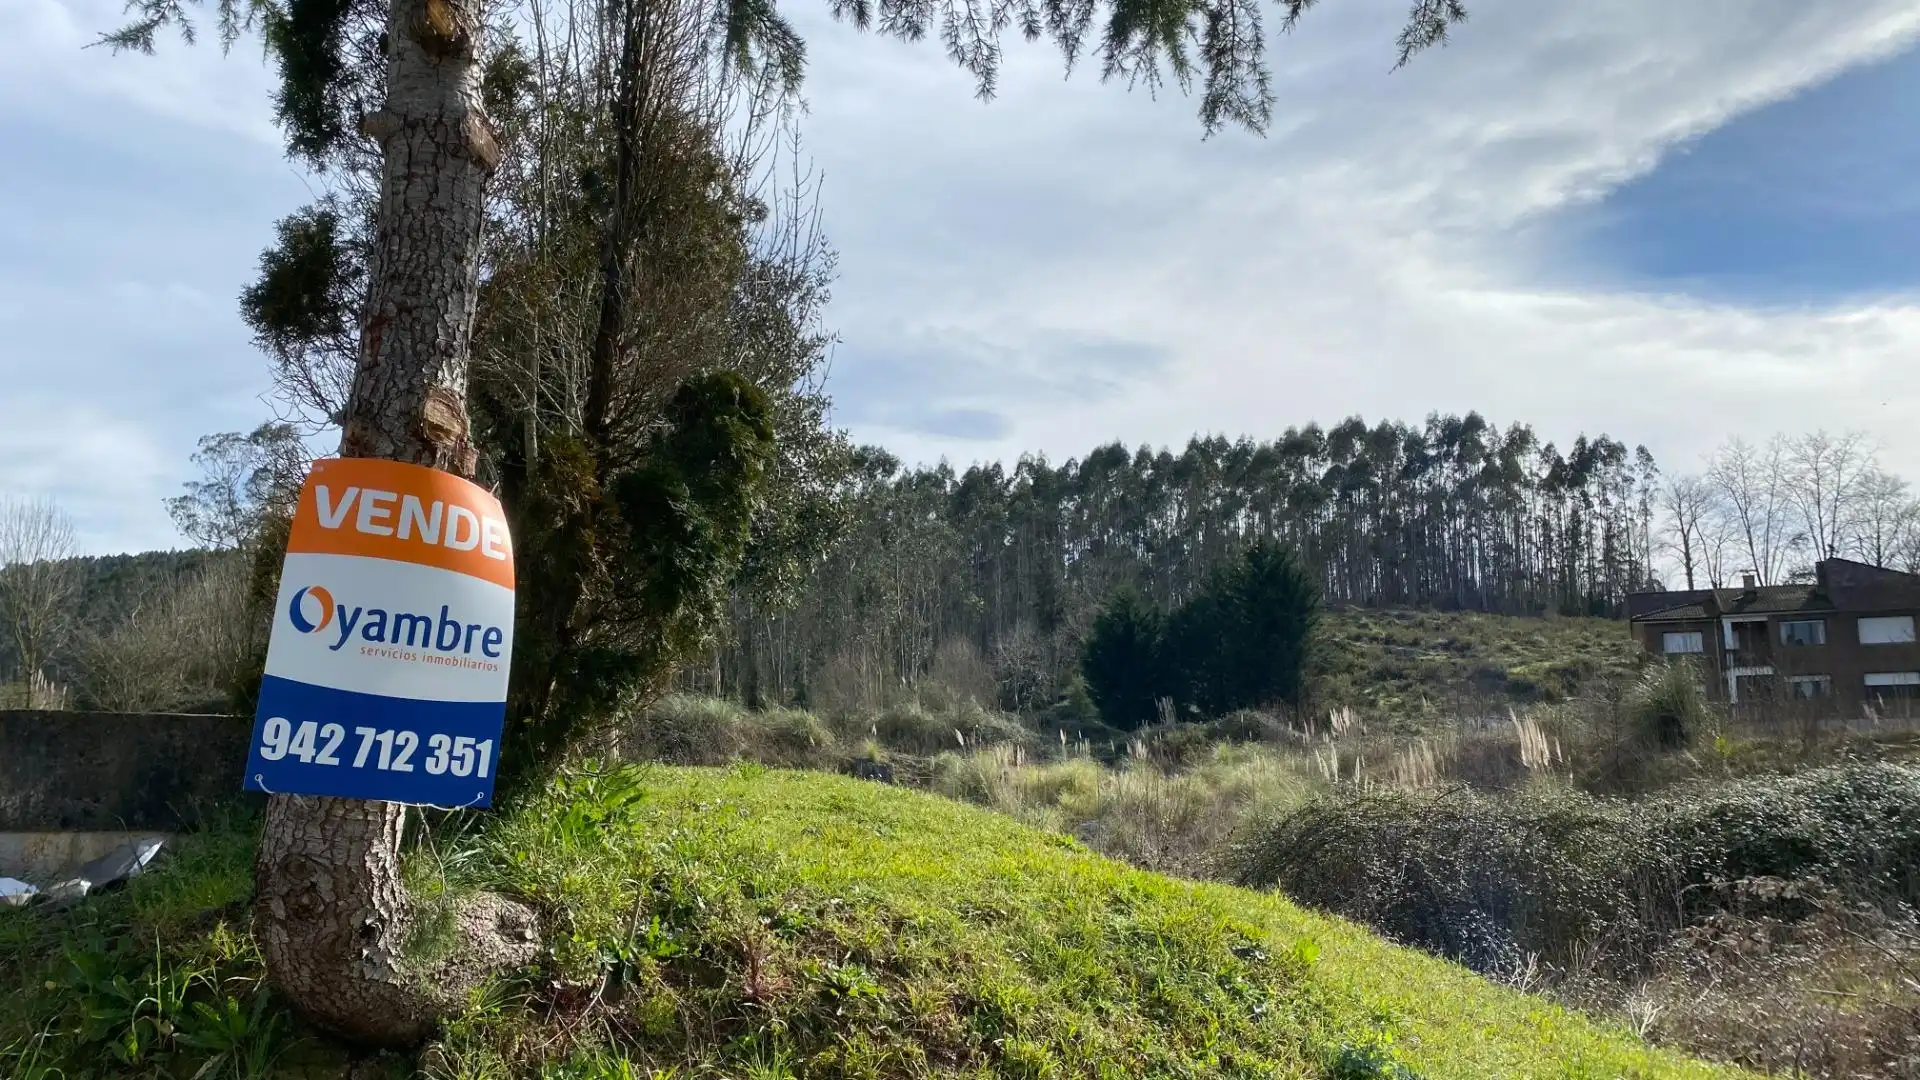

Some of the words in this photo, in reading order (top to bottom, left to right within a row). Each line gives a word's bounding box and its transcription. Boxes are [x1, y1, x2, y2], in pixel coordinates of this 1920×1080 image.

[314, 484, 508, 561] VENDE
[289, 585, 503, 657] Oyambre
[360, 646, 417, 662] servicios
[422, 653, 498, 672] inmobiliarios
[260, 716, 345, 766] 942
[352, 726, 419, 773] 712
[425, 733, 493, 778] 351
